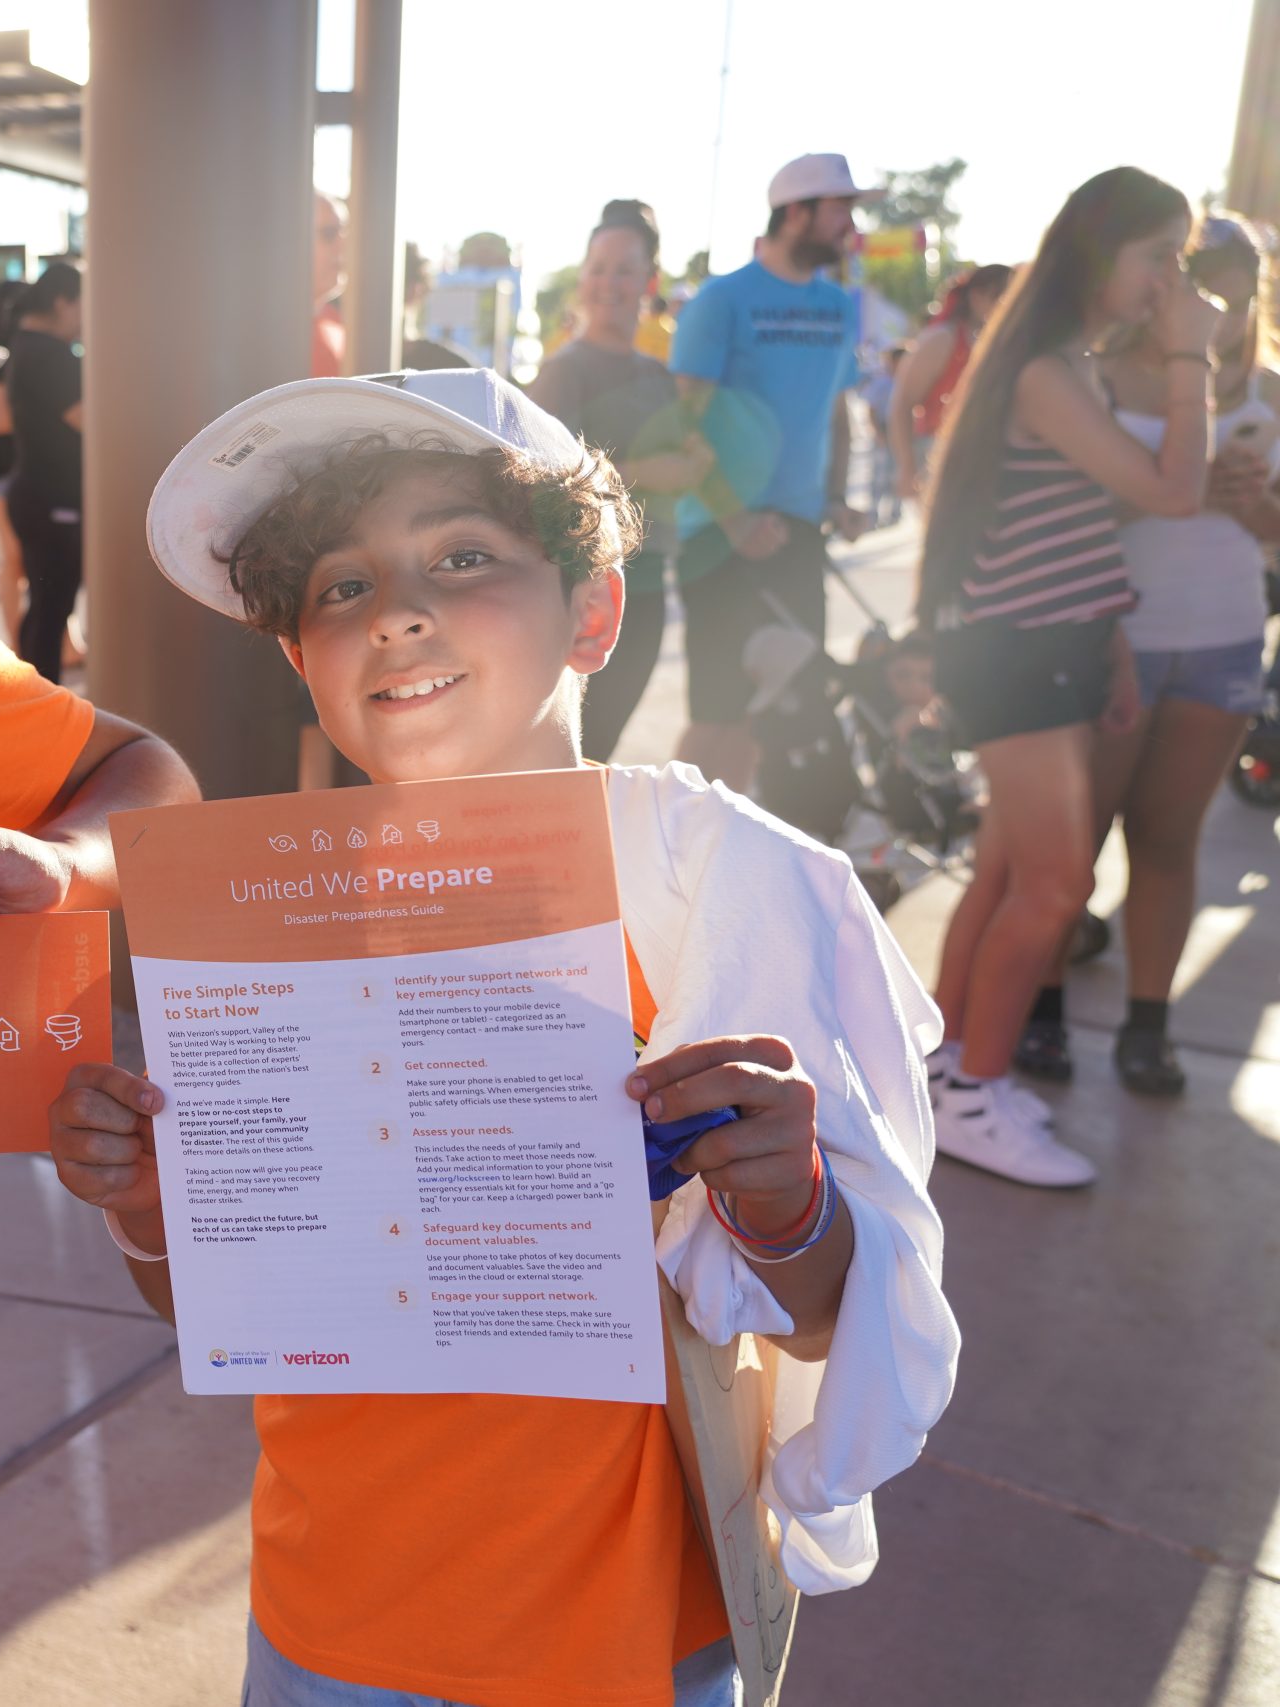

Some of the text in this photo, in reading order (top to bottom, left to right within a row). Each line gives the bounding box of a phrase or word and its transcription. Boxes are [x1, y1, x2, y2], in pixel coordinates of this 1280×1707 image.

[229, 865, 494, 903] United We Prepare
[283, 903, 445, 926] Disaster Preparedness Guide
[394, 965, 588, 986] Identify your support network and
[162, 983, 295, 1000] Five Simple Steps
[362, 985, 372, 998] 1
[395, 984, 535, 1002] key emergency contacts.
[165, 1005, 259, 1020] to Start Now
[371, 1062, 382, 1074] 2
[404, 1058, 487, 1071] Get connected.
[192, 1099, 213, 1107] we've
[214, 1098, 235, 1106] made
[243, 1096, 271, 1106] simple.
[252, 1107, 273, 1115] steps
[274, 1106, 283, 1114] to
[178, 1115, 307, 1128] prepare yourself, your family, your
[180, 1125, 309, 1138] organization, and your community
[378, 1127, 389, 1140] 3
[412, 1125, 514, 1138] Assess your needs.
[181, 1138, 192, 1146] for
[193, 1138, 224, 1146] disaster.
[226, 1137, 240, 1145] The
[257, 1136, 265, 1144] of
[266, 1136, 281, 1144] this
[282, 1135, 304, 1145] guide
[182, 1148, 204, 1156] offers
[225, 1147, 251, 1155] details
[262, 1146, 284, 1154] these
[285, 1145, 314, 1153] actions.
[191, 1216, 203, 1224] No
[234, 1215, 261, 1224] predict
[277, 1214, 304, 1222] future,
[211, 1225, 219, 1233] of
[264, 1225, 285, 1233] steps
[286, 1224, 295, 1232] to
[297, 1224, 327, 1232] prepare
[389, 1223, 400, 1236] 4
[422, 1220, 592, 1234] Safeguard key documents and
[193, 1235, 258, 1243] for the unknown.
[424, 1235, 539, 1246] document valuables.
[426, 1252, 622, 1263] Use your phone to take photos of key documents
[486, 1262, 524, 1271] valuables.
[526, 1262, 545, 1270] Save
[547, 1262, 561, 1270] the
[562, 1262, 585, 1270] video
[587, 1262, 602, 1270] and
[398, 1290, 408, 1303] 5
[431, 1291, 598, 1303] Engage your support network.
[230, 1357, 268, 1365] UNITED WAY
[282, 1350, 351, 1366] verizon
[628, 1363, 636, 1373] 1
